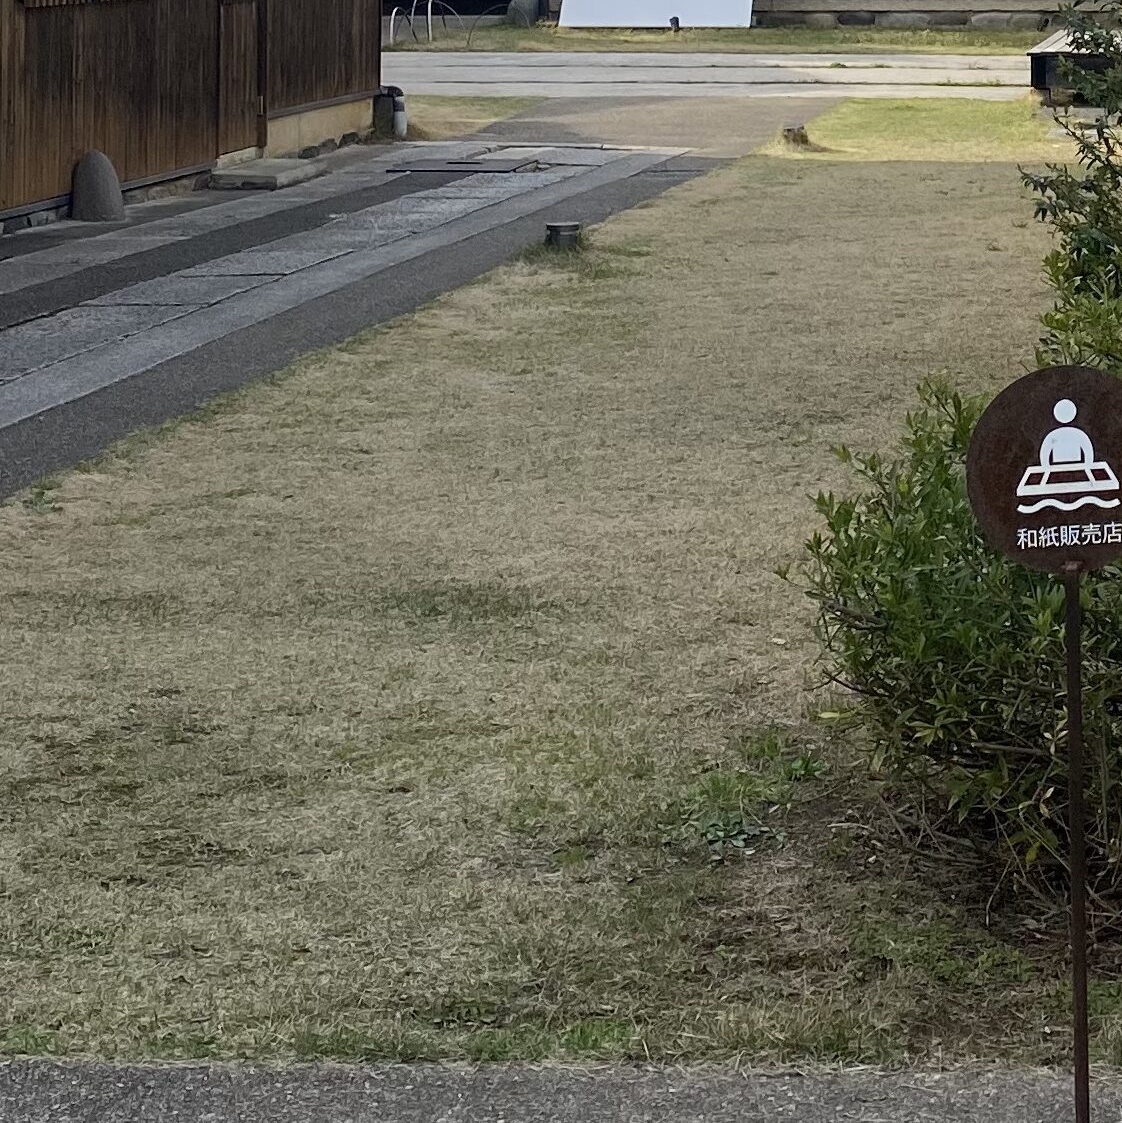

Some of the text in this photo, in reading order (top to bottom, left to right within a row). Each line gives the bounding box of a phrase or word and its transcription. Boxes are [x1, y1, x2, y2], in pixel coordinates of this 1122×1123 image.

[1016, 521, 1122, 550] 和紙販売店
